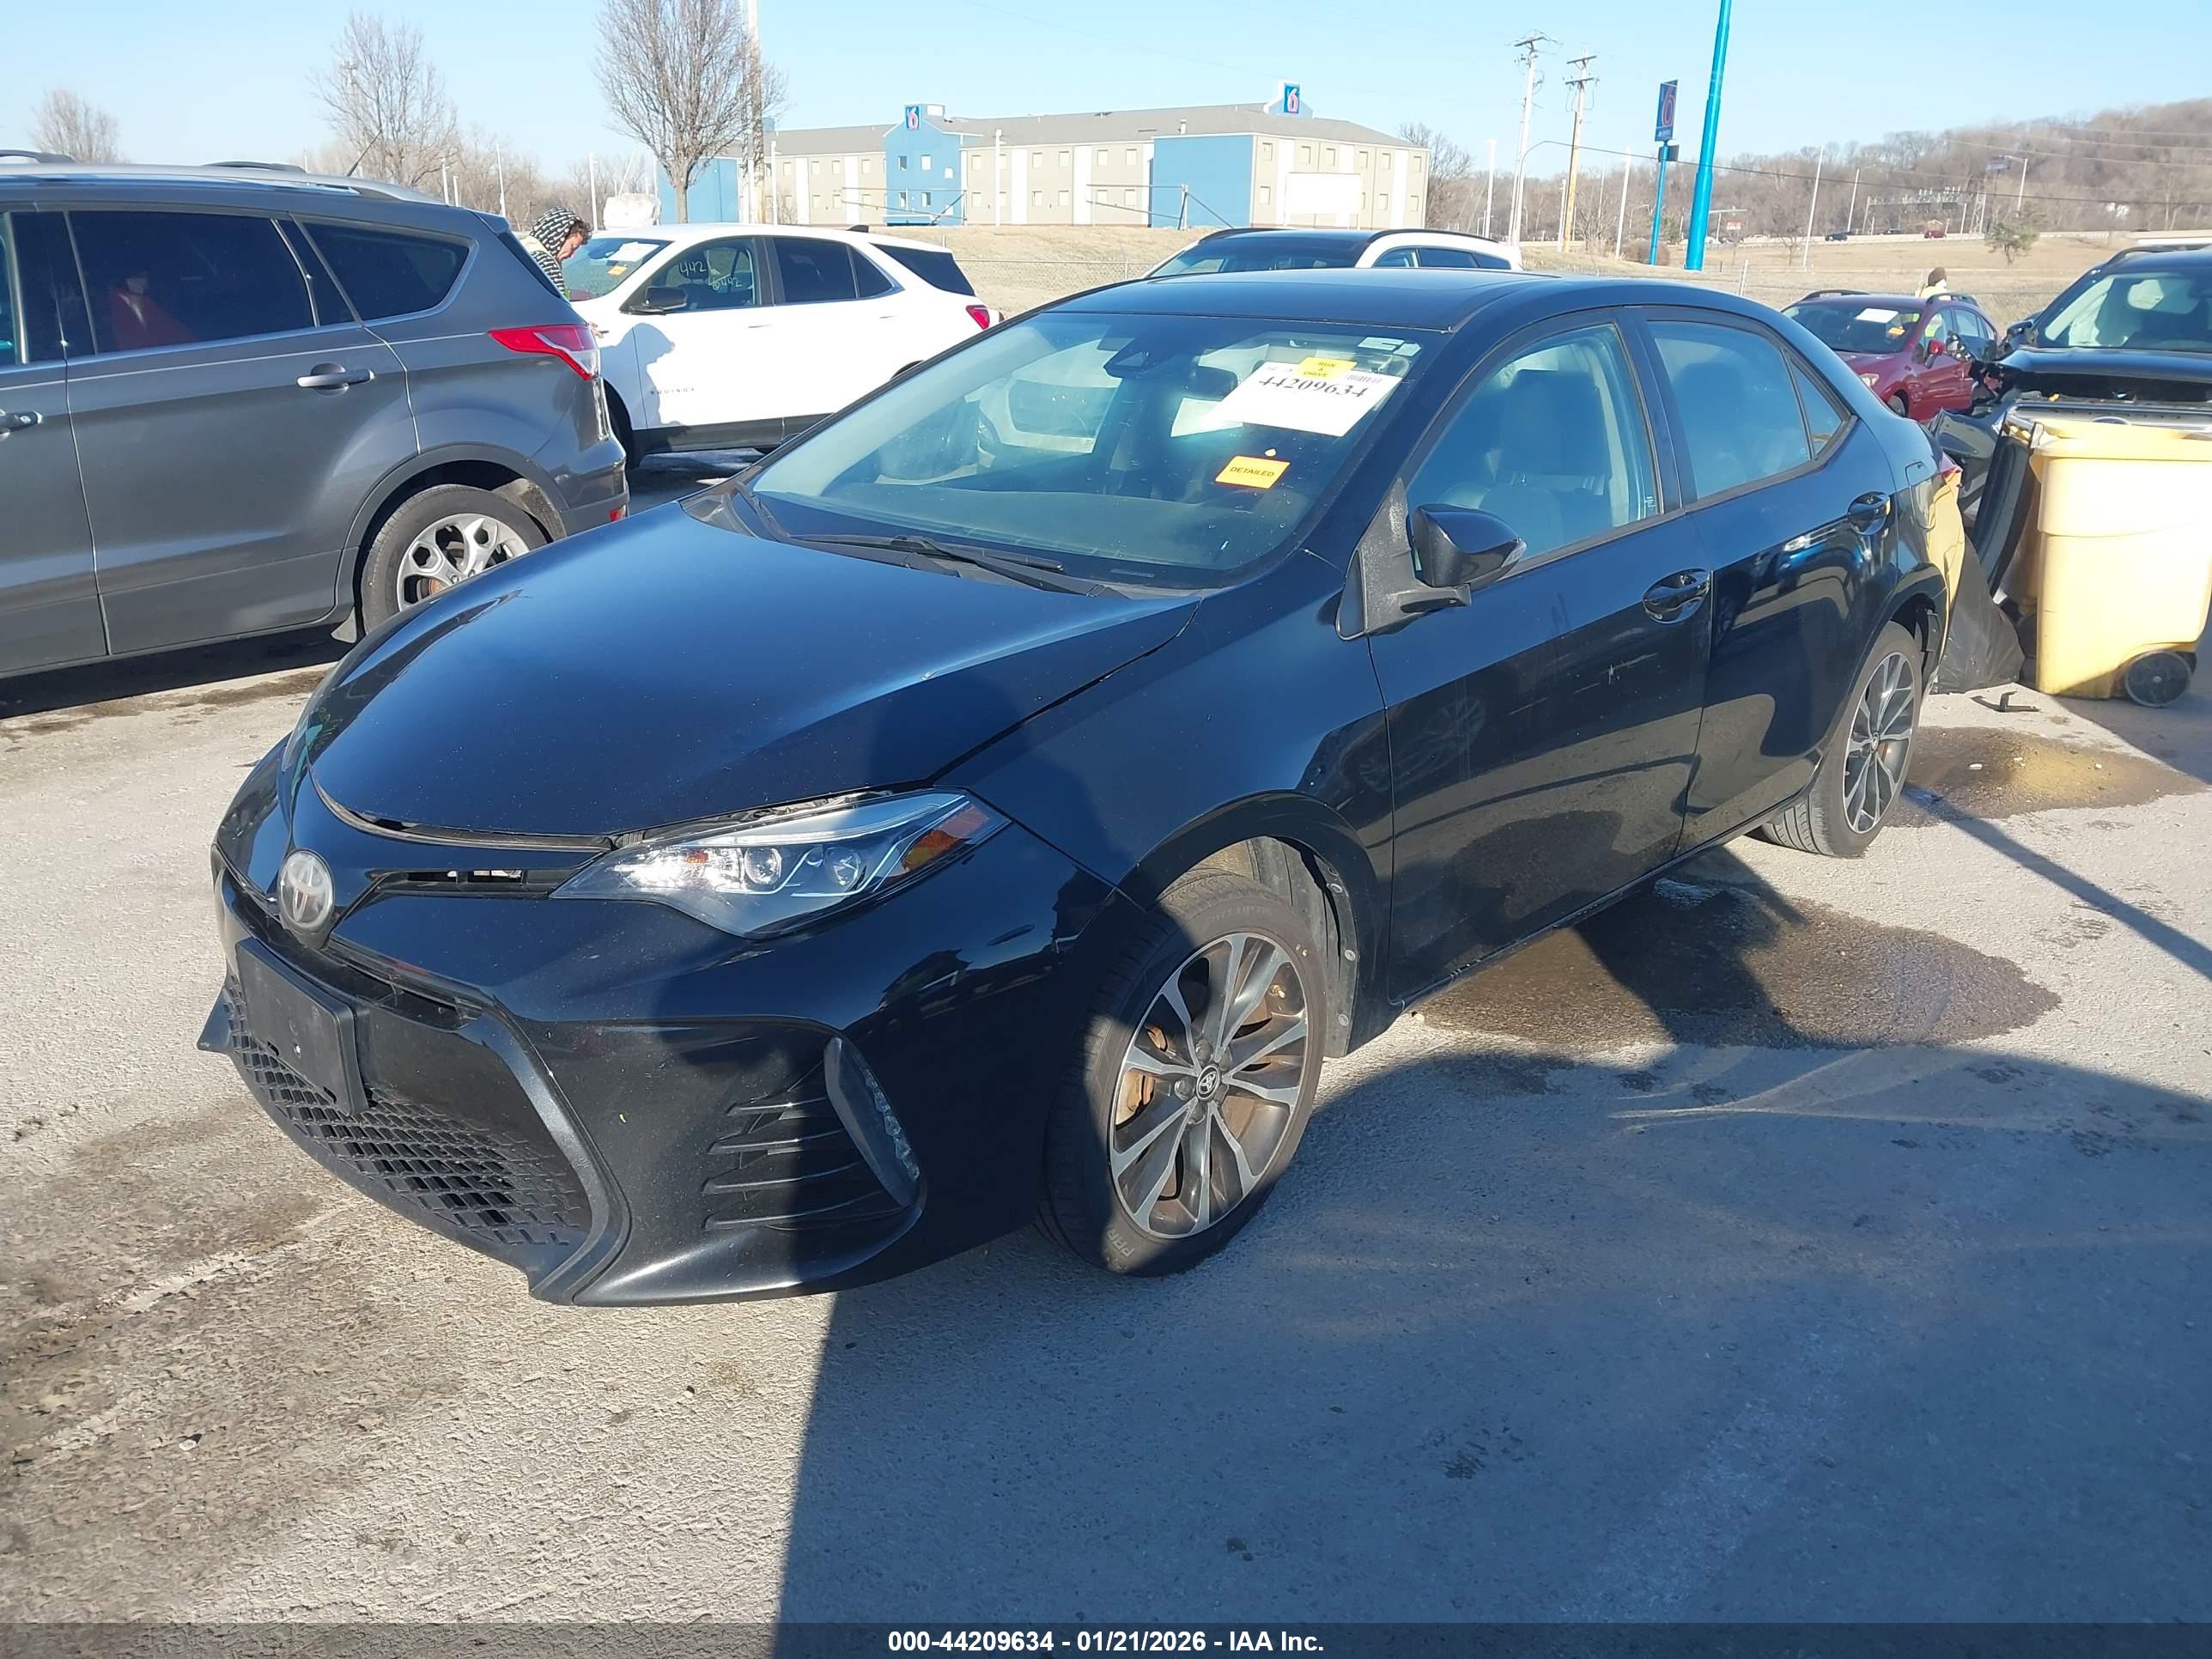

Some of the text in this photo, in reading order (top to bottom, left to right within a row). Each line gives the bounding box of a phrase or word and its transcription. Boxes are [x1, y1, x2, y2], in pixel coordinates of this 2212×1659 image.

[1288, 88, 1298, 112] 6
[1662, 87, 1674, 127] 6
[908, 107, 919, 130] 6
[679, 260, 707, 276] 442
[1259, 376, 1369, 398] 44209634
[1230, 466, 1275, 477] DETAILED
